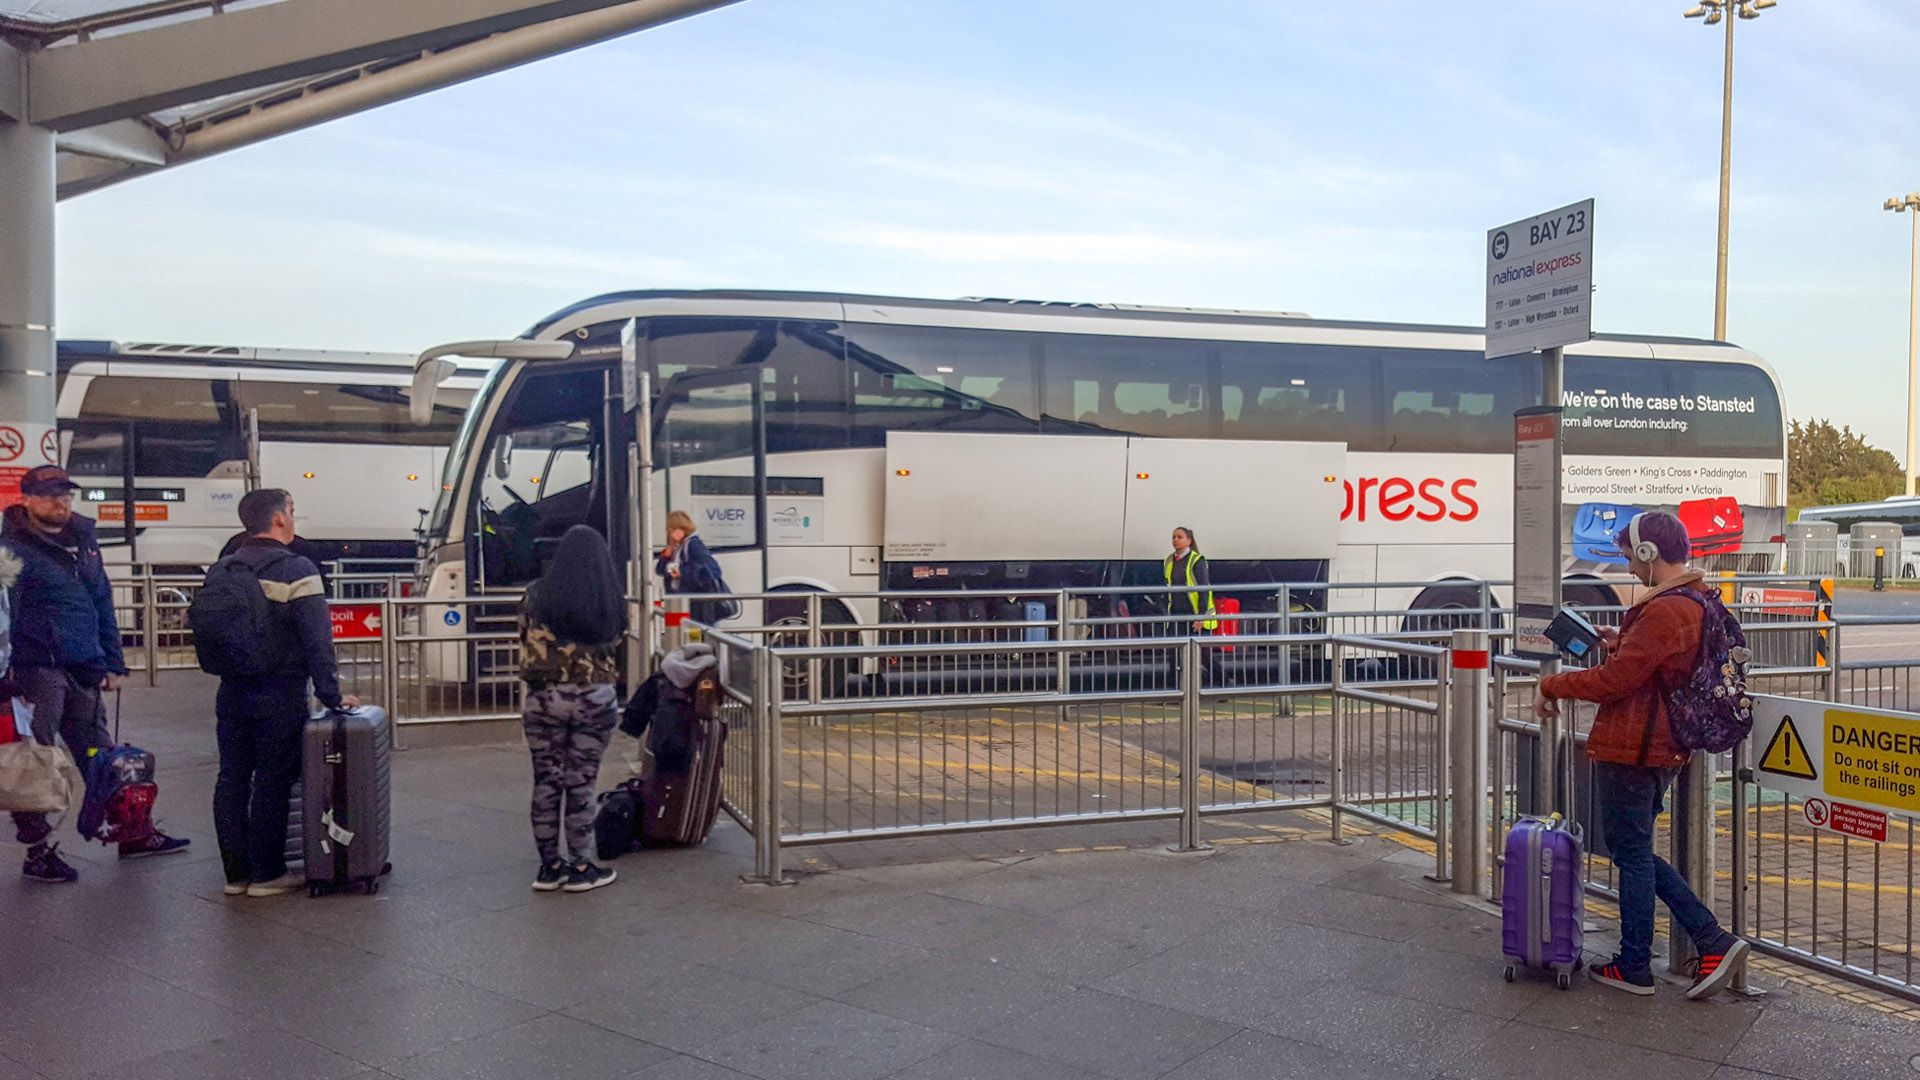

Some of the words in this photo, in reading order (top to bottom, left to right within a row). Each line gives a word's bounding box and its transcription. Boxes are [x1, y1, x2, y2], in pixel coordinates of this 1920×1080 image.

[1530, 217, 1562, 246] BAY
[1566, 210, 1585, 236] 23
[1493, 260, 1535, 286] national
[1536, 252, 1582, 276] express
[1509, 298, 1521, 307] Luton
[1527, 293, 1546, 303] Coventry
[1552, 284, 1579, 297] Birmingham
[1508, 318, 1520, 327] Luton
[1526, 313, 1536, 324] High
[1537, 310, 1557, 321] Wycombe
[1563, 304, 1579, 316] Oxford
[1601, 395, 1619, 409] on
[1621, 392, 1644, 410] the
[1646, 397, 1678, 410] case
[1680, 395, 1694, 411] to
[1697, 395, 1755, 413] Stansted
[1561, 416, 1580, 428] rom
[1582, 416, 1592, 428] all
[1593, 419, 1613, 429] over
[1614, 417, 1647, 430] London
[1649, 417, 1689, 433] including:
[1567, 465, 1603, 476] Golders
[1604, 466, 1631, 477] Green
[1640, 467, 1666, 479] King's
[1667, 467, 1692, 477] Cross
[1700, 467, 1748, 481] Paddington
[1567, 483, 1609, 496] Liverpool
[1610, 483, 1637, 494] Street
[1645, 484, 1684, 495] Stratford
[1691, 485, 1723, 495] Victoria
[706, 508, 746, 521] VUER
[1832, 725, 1920, 757] DANGER
[1834, 752, 1853, 767] Do
[1856, 758, 1879, 771] not
[1882, 760, 1900, 775] sit
[1904, 766, 1920, 778] on
[1839, 770, 1860, 785] the
[1864, 776, 1916, 797] railings
[1832, 804, 1842, 813] No
[1843, 808, 1885, 823] unauthorised
[1834, 814, 1857, 825] person
[1858, 819, 1883, 831] beyond
[1842, 823, 1855, 832] this
[1856, 827, 1873, 837] point
